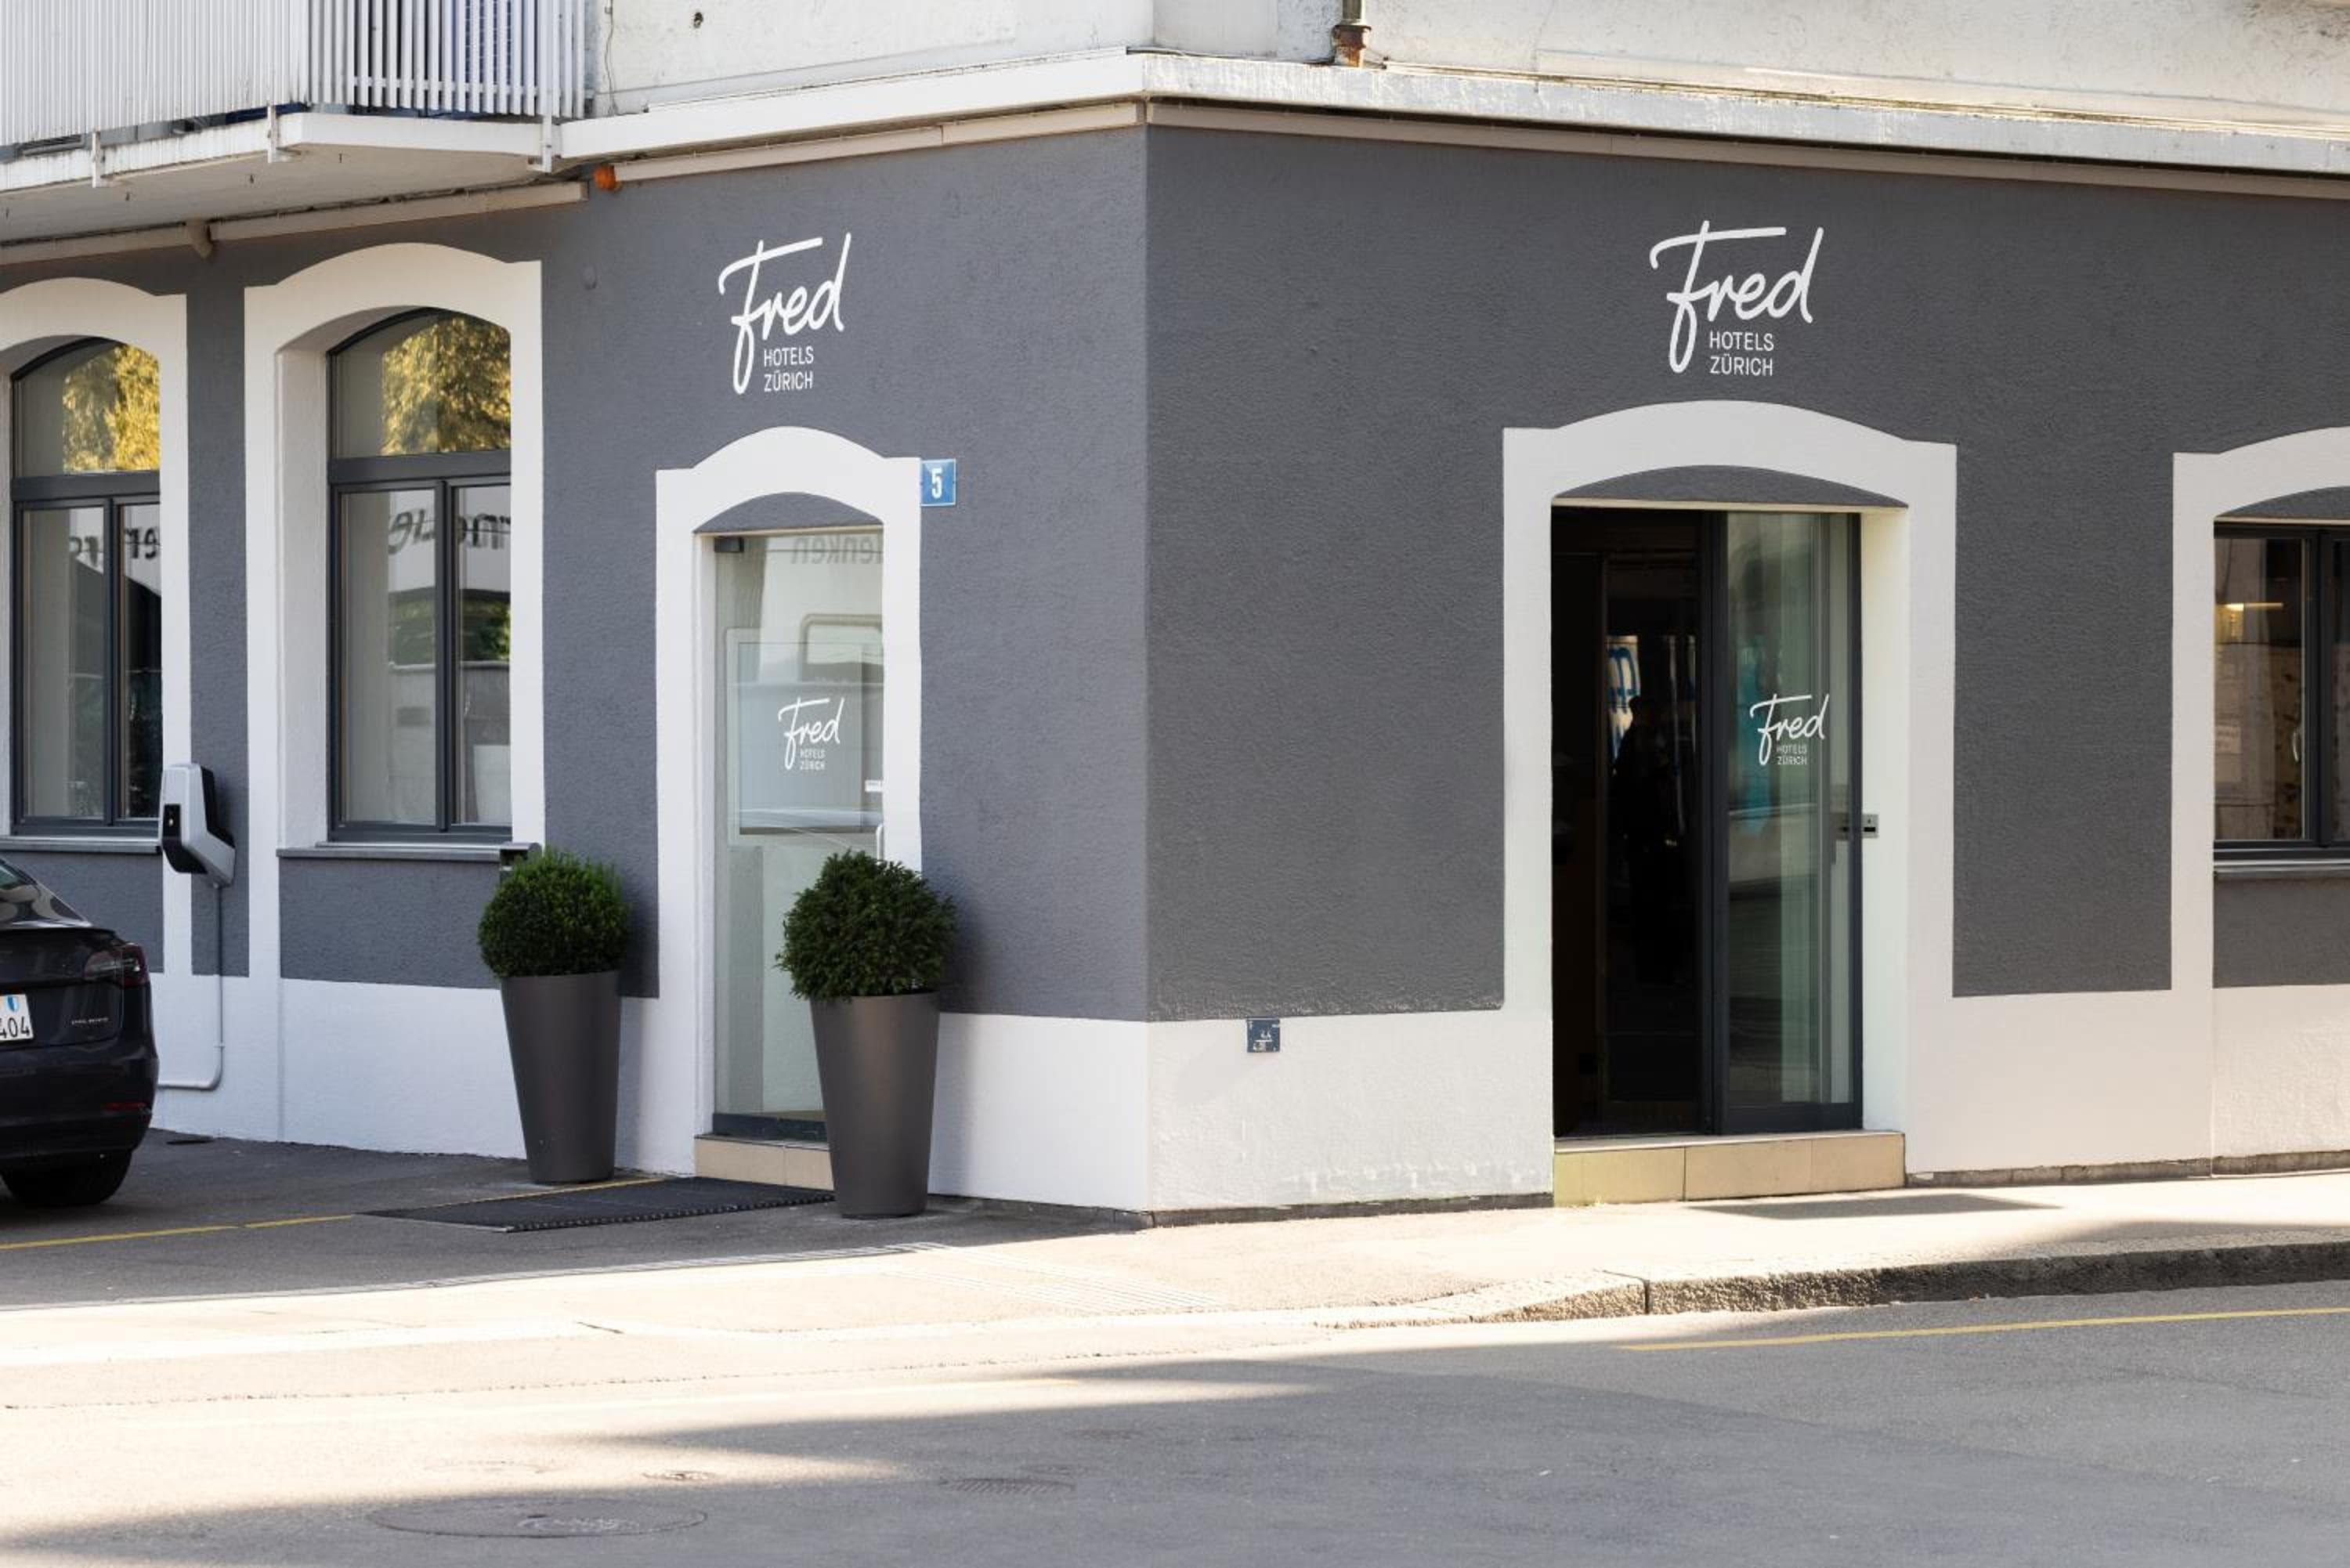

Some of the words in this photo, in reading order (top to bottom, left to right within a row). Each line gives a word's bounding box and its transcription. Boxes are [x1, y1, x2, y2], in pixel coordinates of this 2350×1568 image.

[1649, 220, 1824, 374] Fred
[718, 232, 852, 395] Fred
[763, 345, 815, 367] HOTELS
[1709, 331, 1774, 352] HOTELS
[1709, 353, 1773, 376] ZÜRICH
[764, 370, 814, 392] ZÜRICH
[930, 467, 942, 498] 5
[778, 696, 845, 770] Fred
[1749, 693, 1830, 766] Fred
